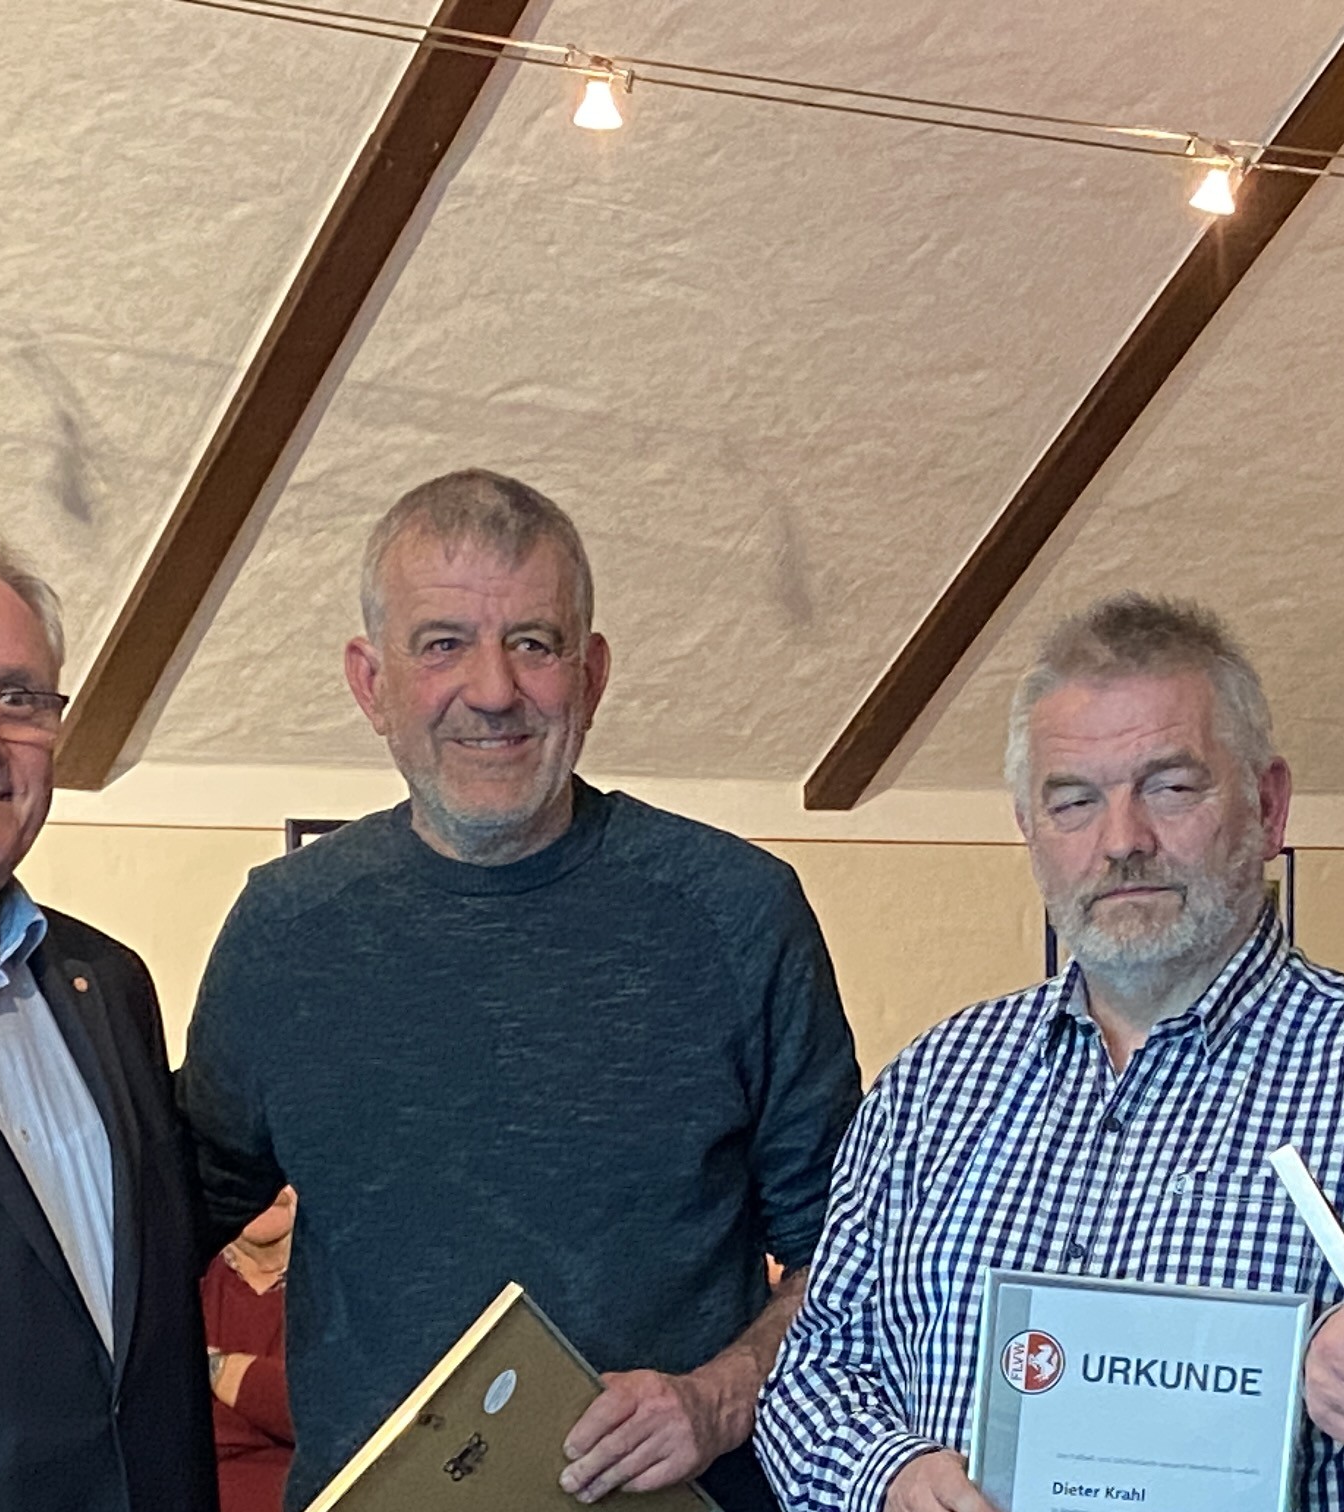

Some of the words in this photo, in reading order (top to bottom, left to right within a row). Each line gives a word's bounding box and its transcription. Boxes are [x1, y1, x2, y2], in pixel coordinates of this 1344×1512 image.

[1010, 1341, 1025, 1381] FLVW
[1082, 1353, 1263, 1396] URKUNDE
[1052, 1482, 1100, 1498] Dieter
[1105, 1486, 1146, 1502] Krahl
